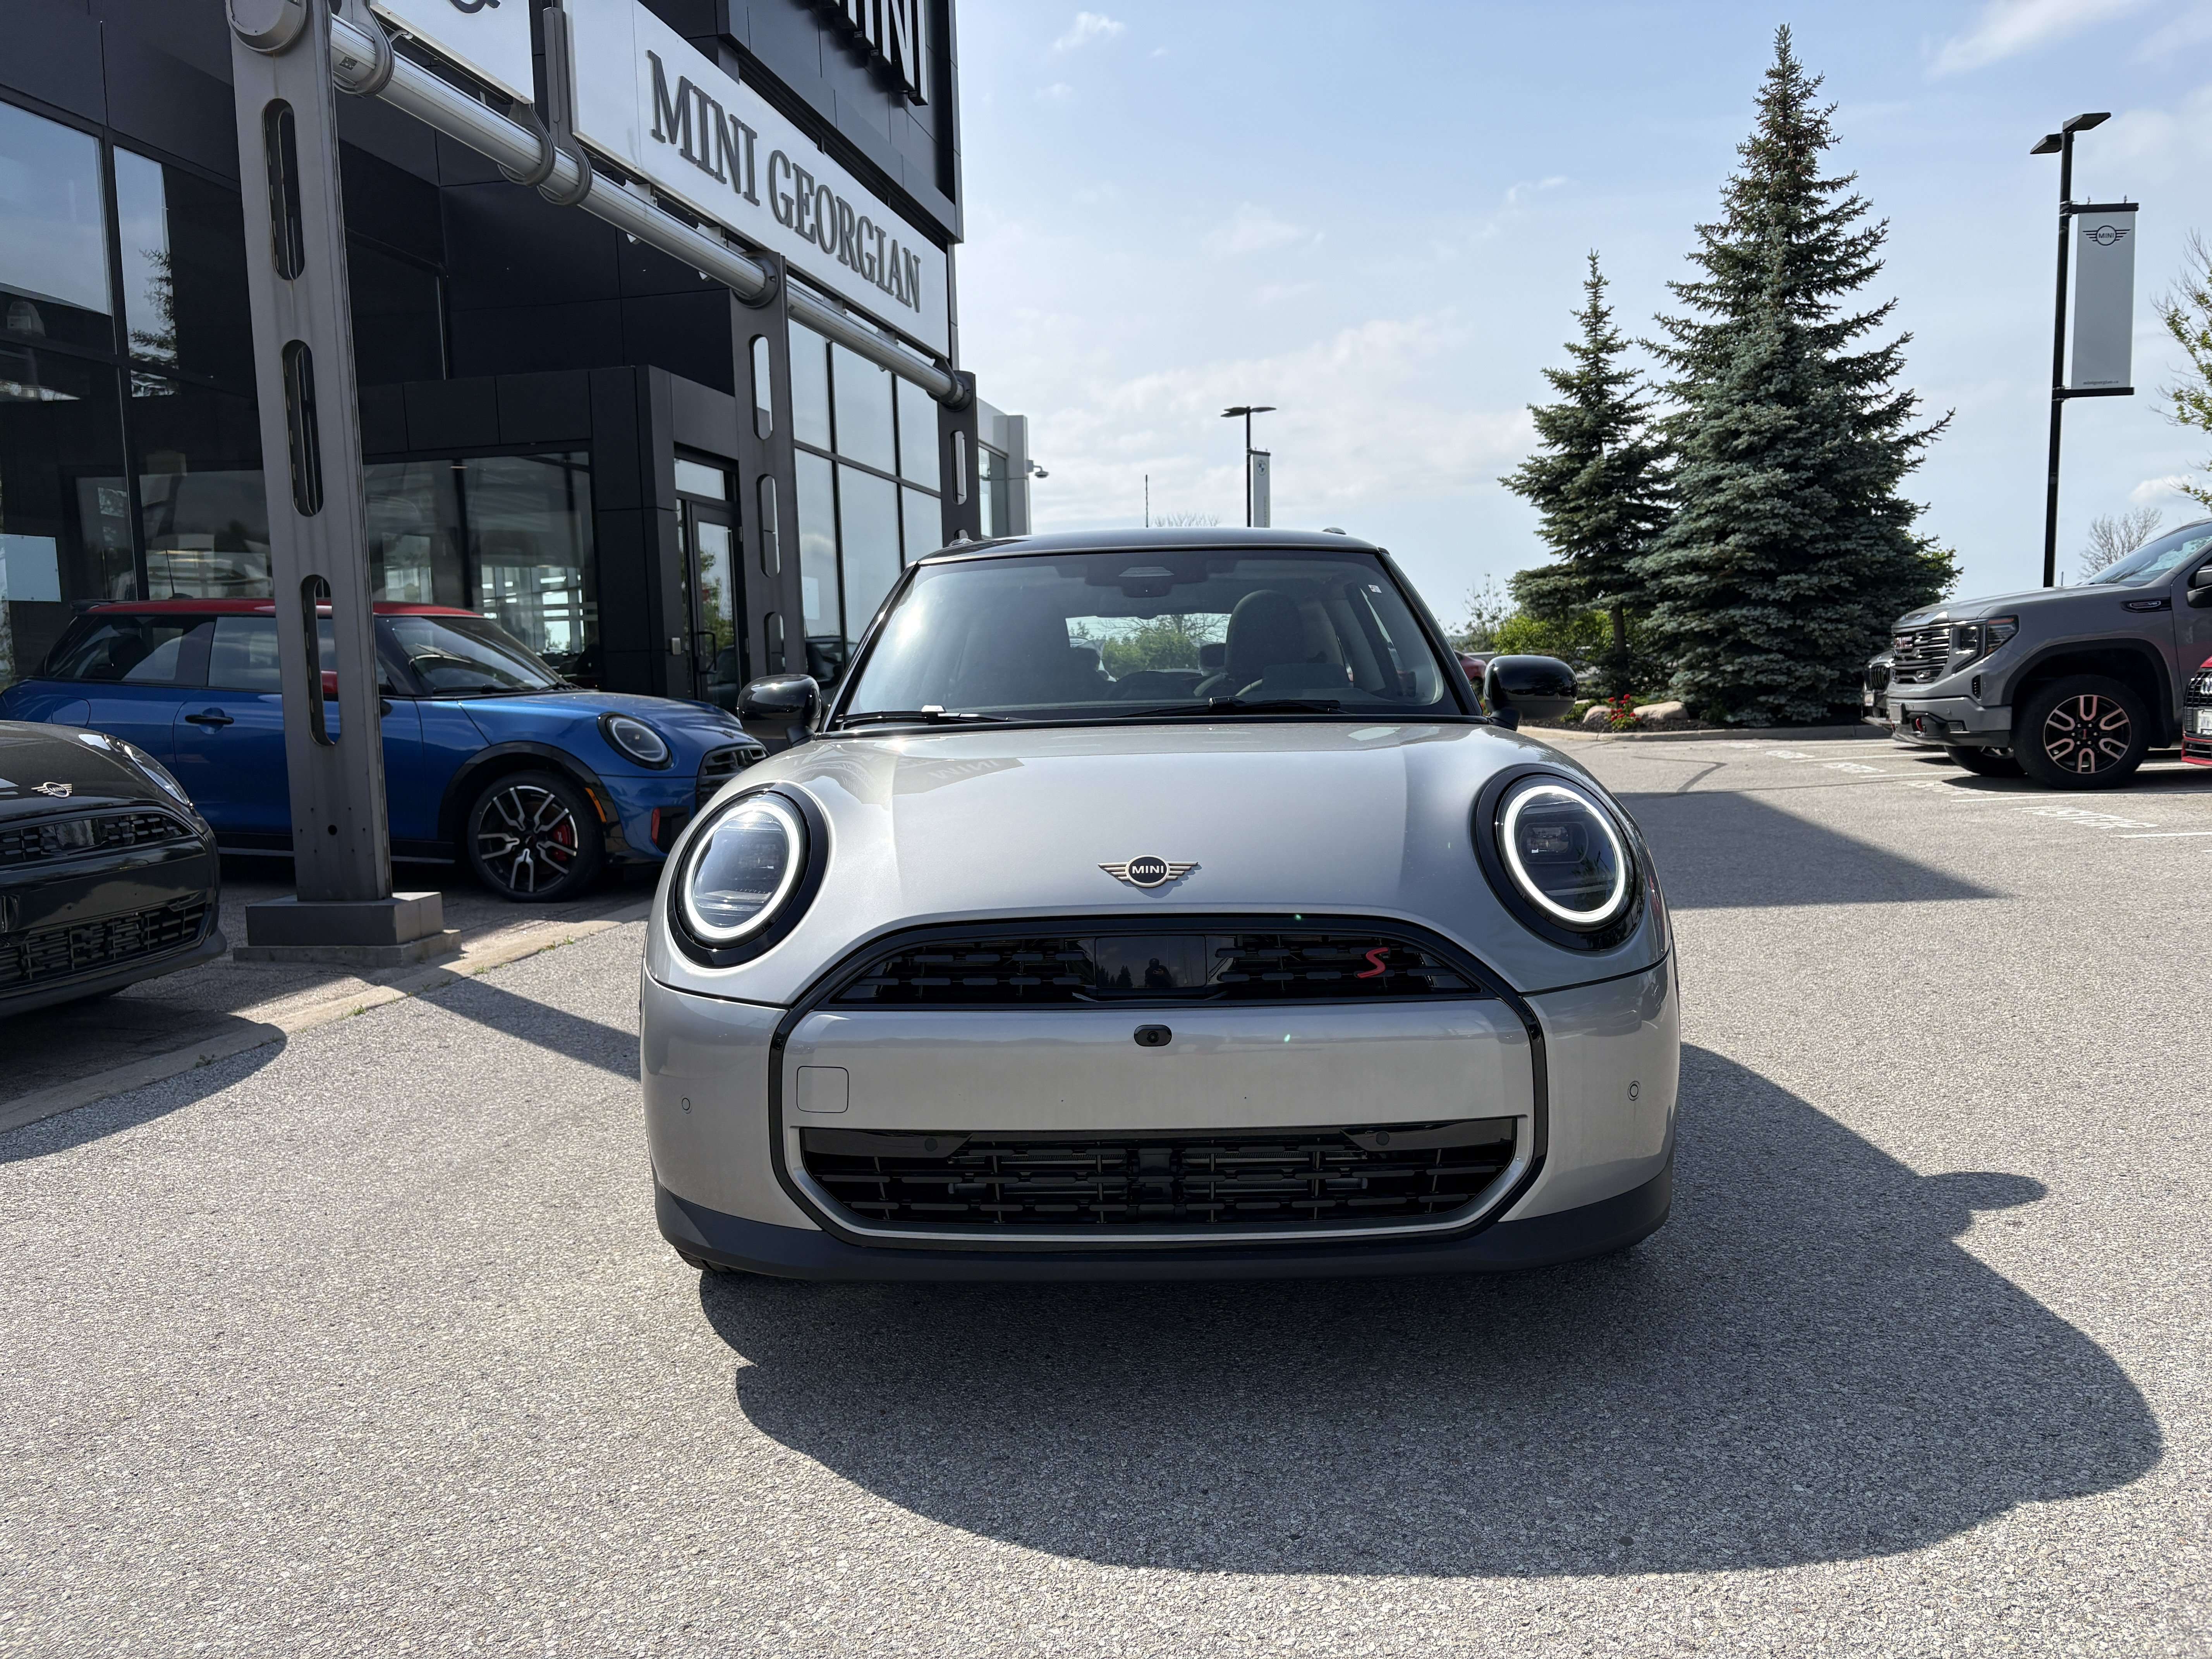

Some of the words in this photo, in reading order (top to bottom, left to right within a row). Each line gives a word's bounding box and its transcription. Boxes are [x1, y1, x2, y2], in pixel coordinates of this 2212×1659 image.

[647, 50, 760, 207] MINI
[769, 149, 921, 313] GEORGIAN
[1132, 865, 1164, 874] MINI
[1357, 947, 1389, 979] S
